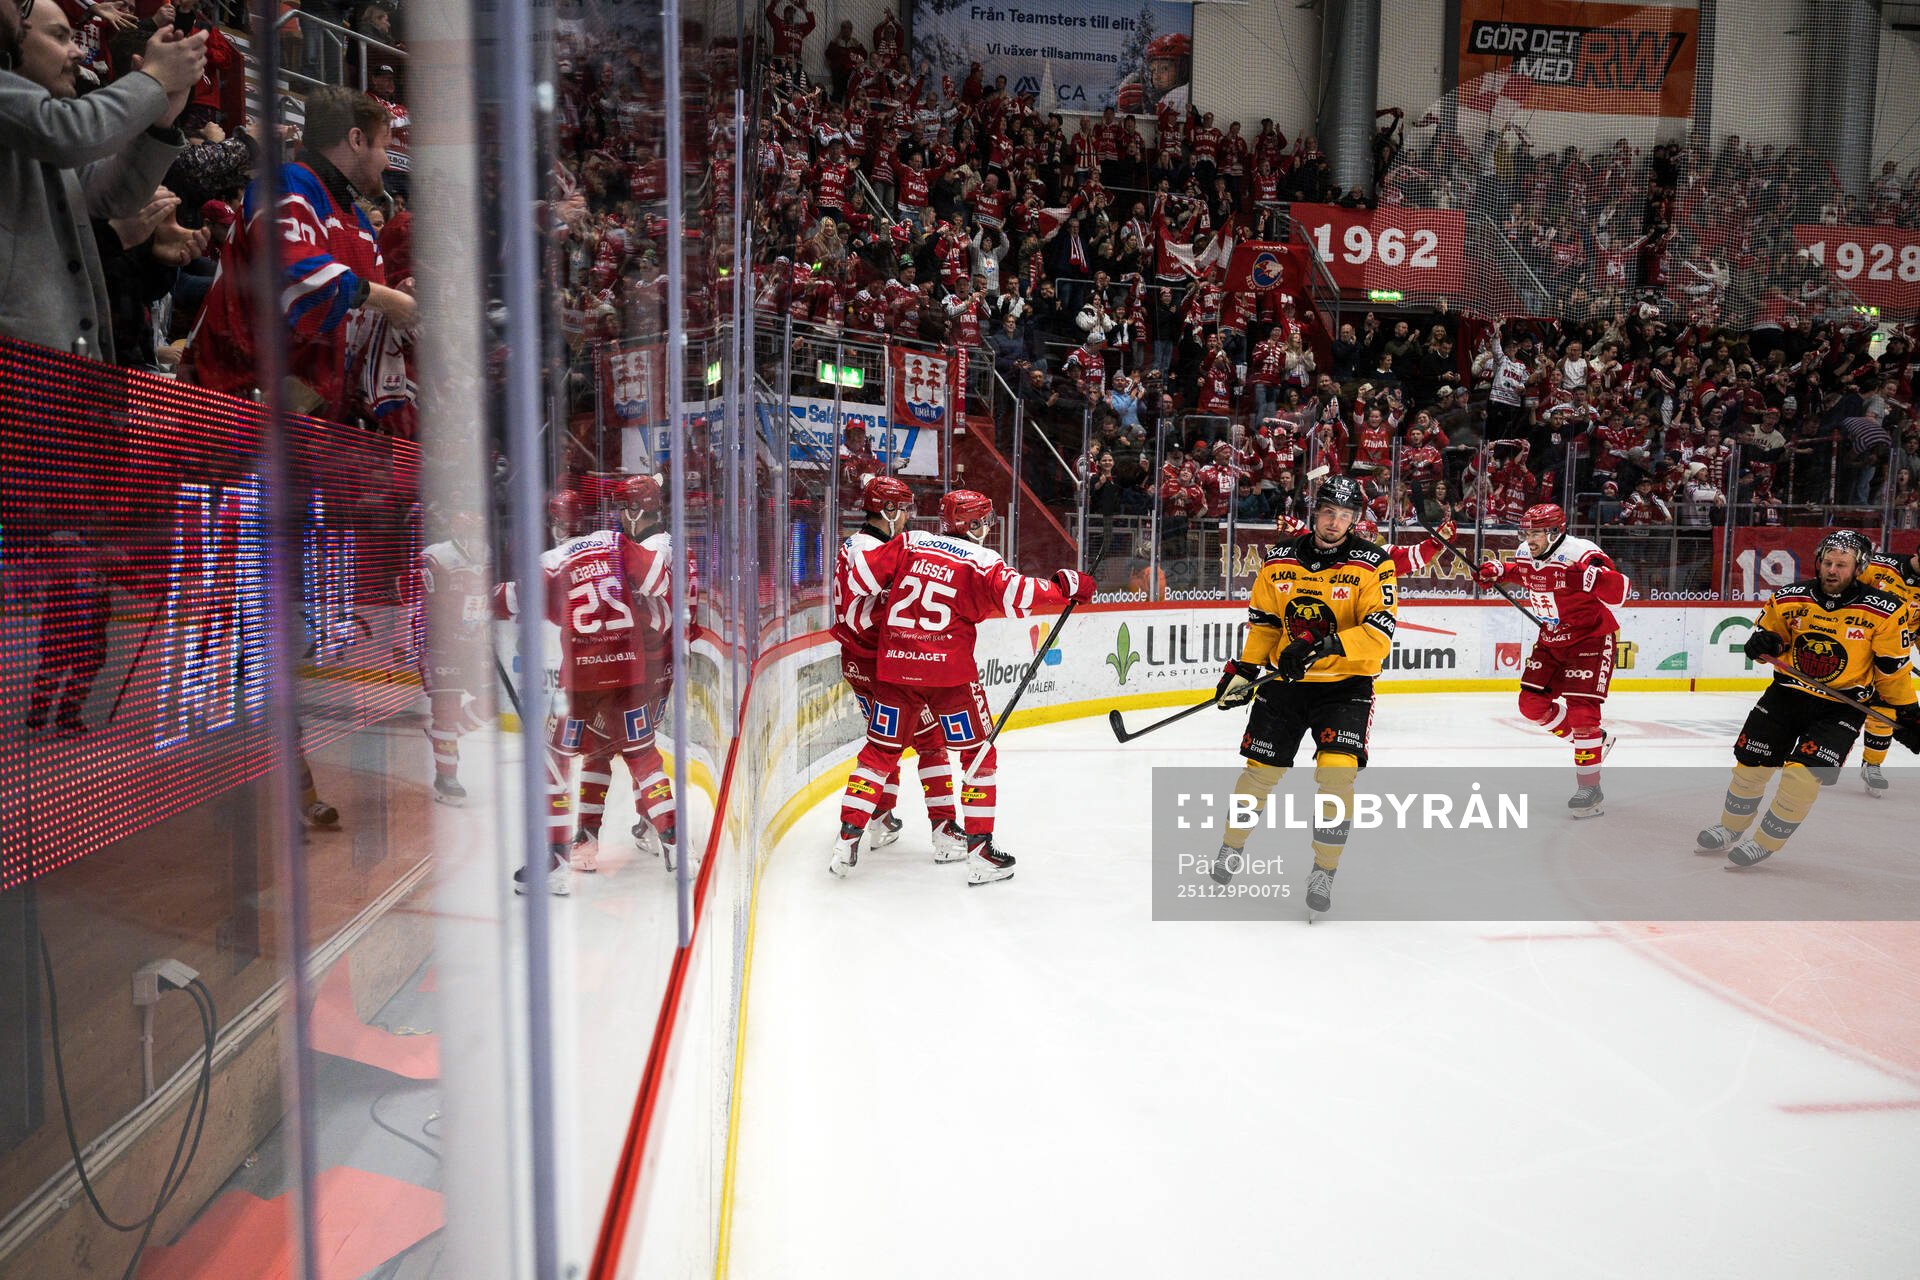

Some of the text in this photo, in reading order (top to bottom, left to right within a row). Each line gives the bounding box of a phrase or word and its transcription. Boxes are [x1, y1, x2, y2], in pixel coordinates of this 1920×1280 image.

[971, 5, 1136, 31] Från Teamsters till elit
[1475, 24, 1580, 53] GÖR DET
[987, 42, 1118, 63] Vi växer tillsammans
[1517, 56, 1574, 82] MED
[1055, 84, 1087, 101] CA
[1313, 223, 1438, 268] 1962
[918, 540, 973, 559] GOODWAY
[1873, 554, 1899, 566] SSAB
[910, 558, 955, 583] NÄSSÉN
[1337, 573, 1360, 586] LKAB
[1776, 586, 1806, 599] SSAB
[887, 575, 958, 632] 25
[1863, 594, 1898, 613] SSAB
[886, 650, 947, 663] BILBOLAGET
[1384, 641, 1456, 669] ium
[1147, 667, 1223, 679] FASTIGH
[1027, 681, 1056, 694] MÅLERI
